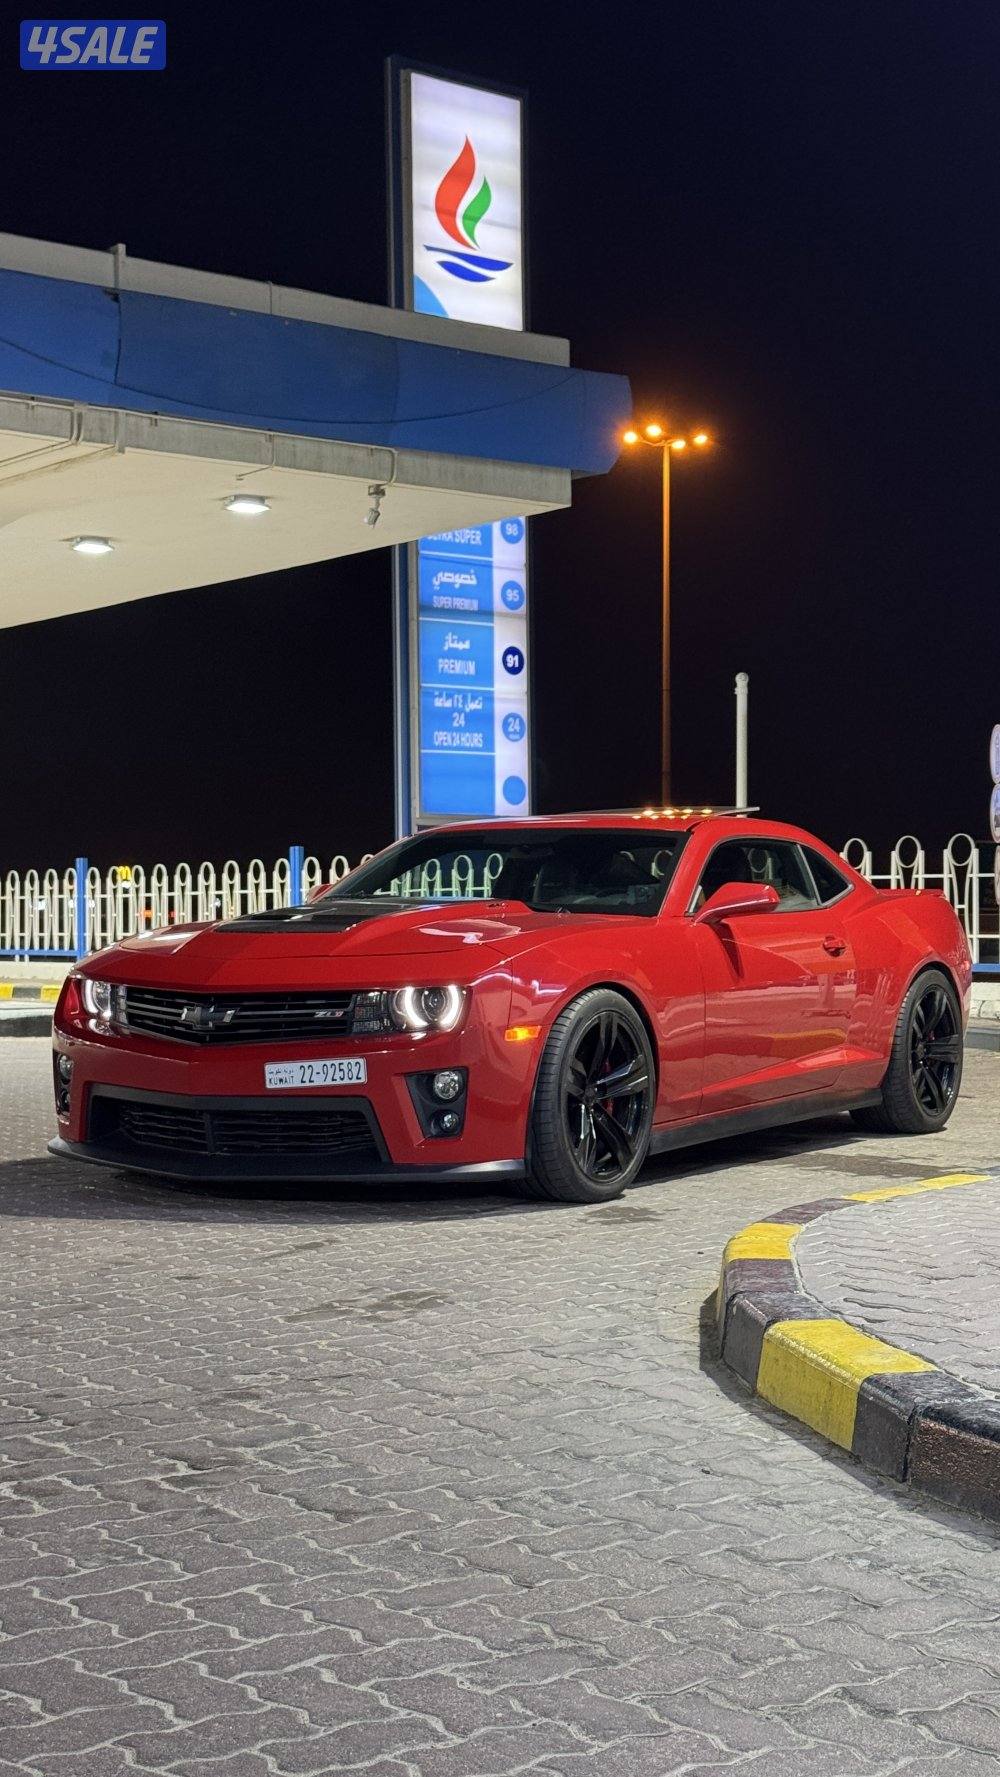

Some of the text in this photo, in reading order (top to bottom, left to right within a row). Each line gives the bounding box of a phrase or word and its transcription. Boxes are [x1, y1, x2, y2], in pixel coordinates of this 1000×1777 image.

[454, 528, 482, 545] SUPER
[432, 569, 477, 590] خصوصي
[432, 595, 452, 609] SUPER
[505, 588, 520, 602] 95
[443, 631, 471, 651] ممتاز
[438, 659, 476, 675] PREMIUM
[505, 653, 519, 668] 91
[452, 712, 466, 728] 24
[507, 717, 521, 732] 24
[433, 731, 483, 748] OPEN 24 HOURS
[268, 1075, 294, 1086] KUWAIT
[299, 1061, 362, 1084] 22-92582
